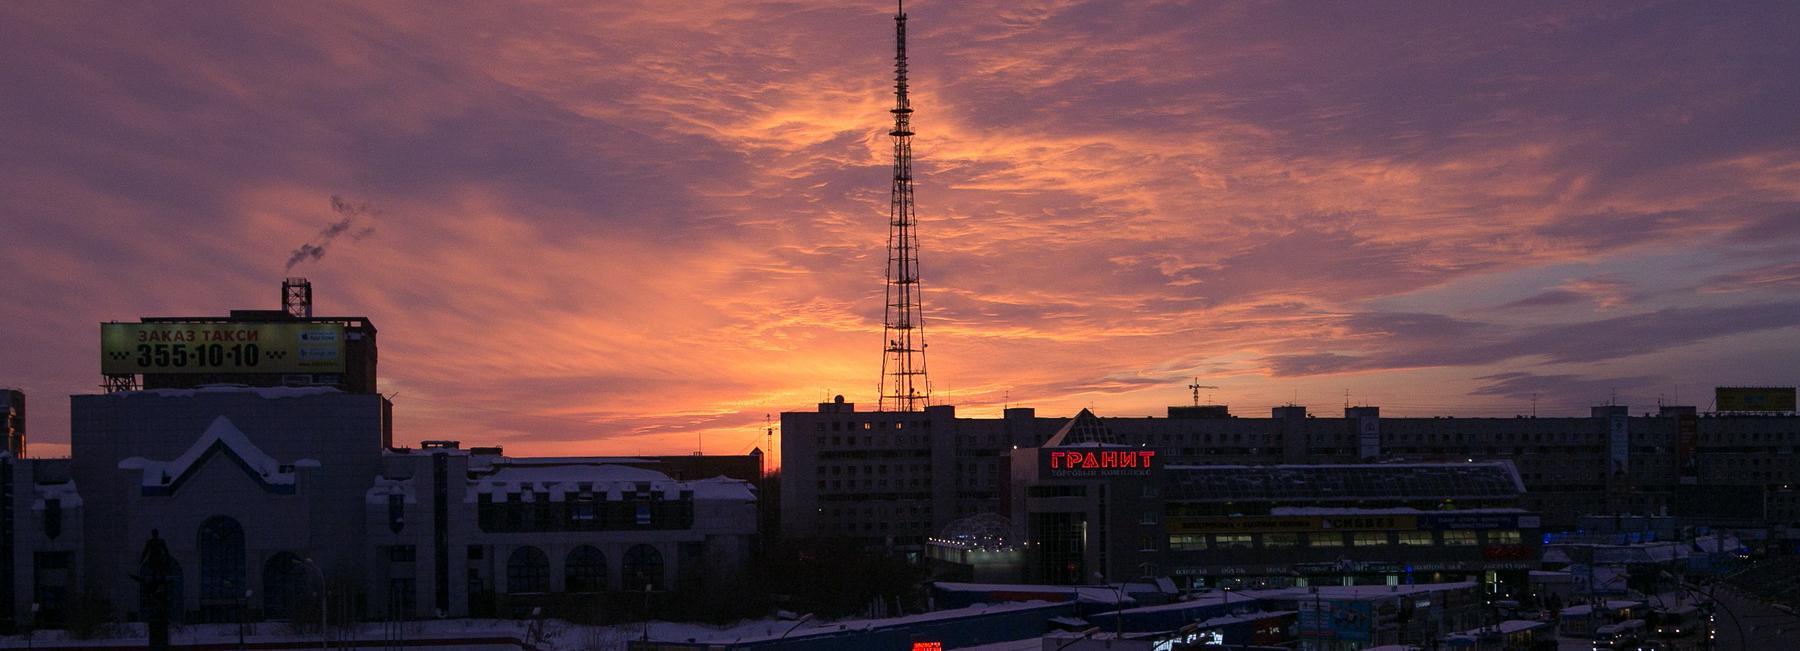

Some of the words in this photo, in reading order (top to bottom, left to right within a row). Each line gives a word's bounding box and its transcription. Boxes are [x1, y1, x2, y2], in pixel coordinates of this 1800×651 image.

[138, 330, 195, 342] ЗАКАЗ
[202, 330, 258, 342] ТАКСИ
[1050, 450, 1156, 469] ГРАНИТ
